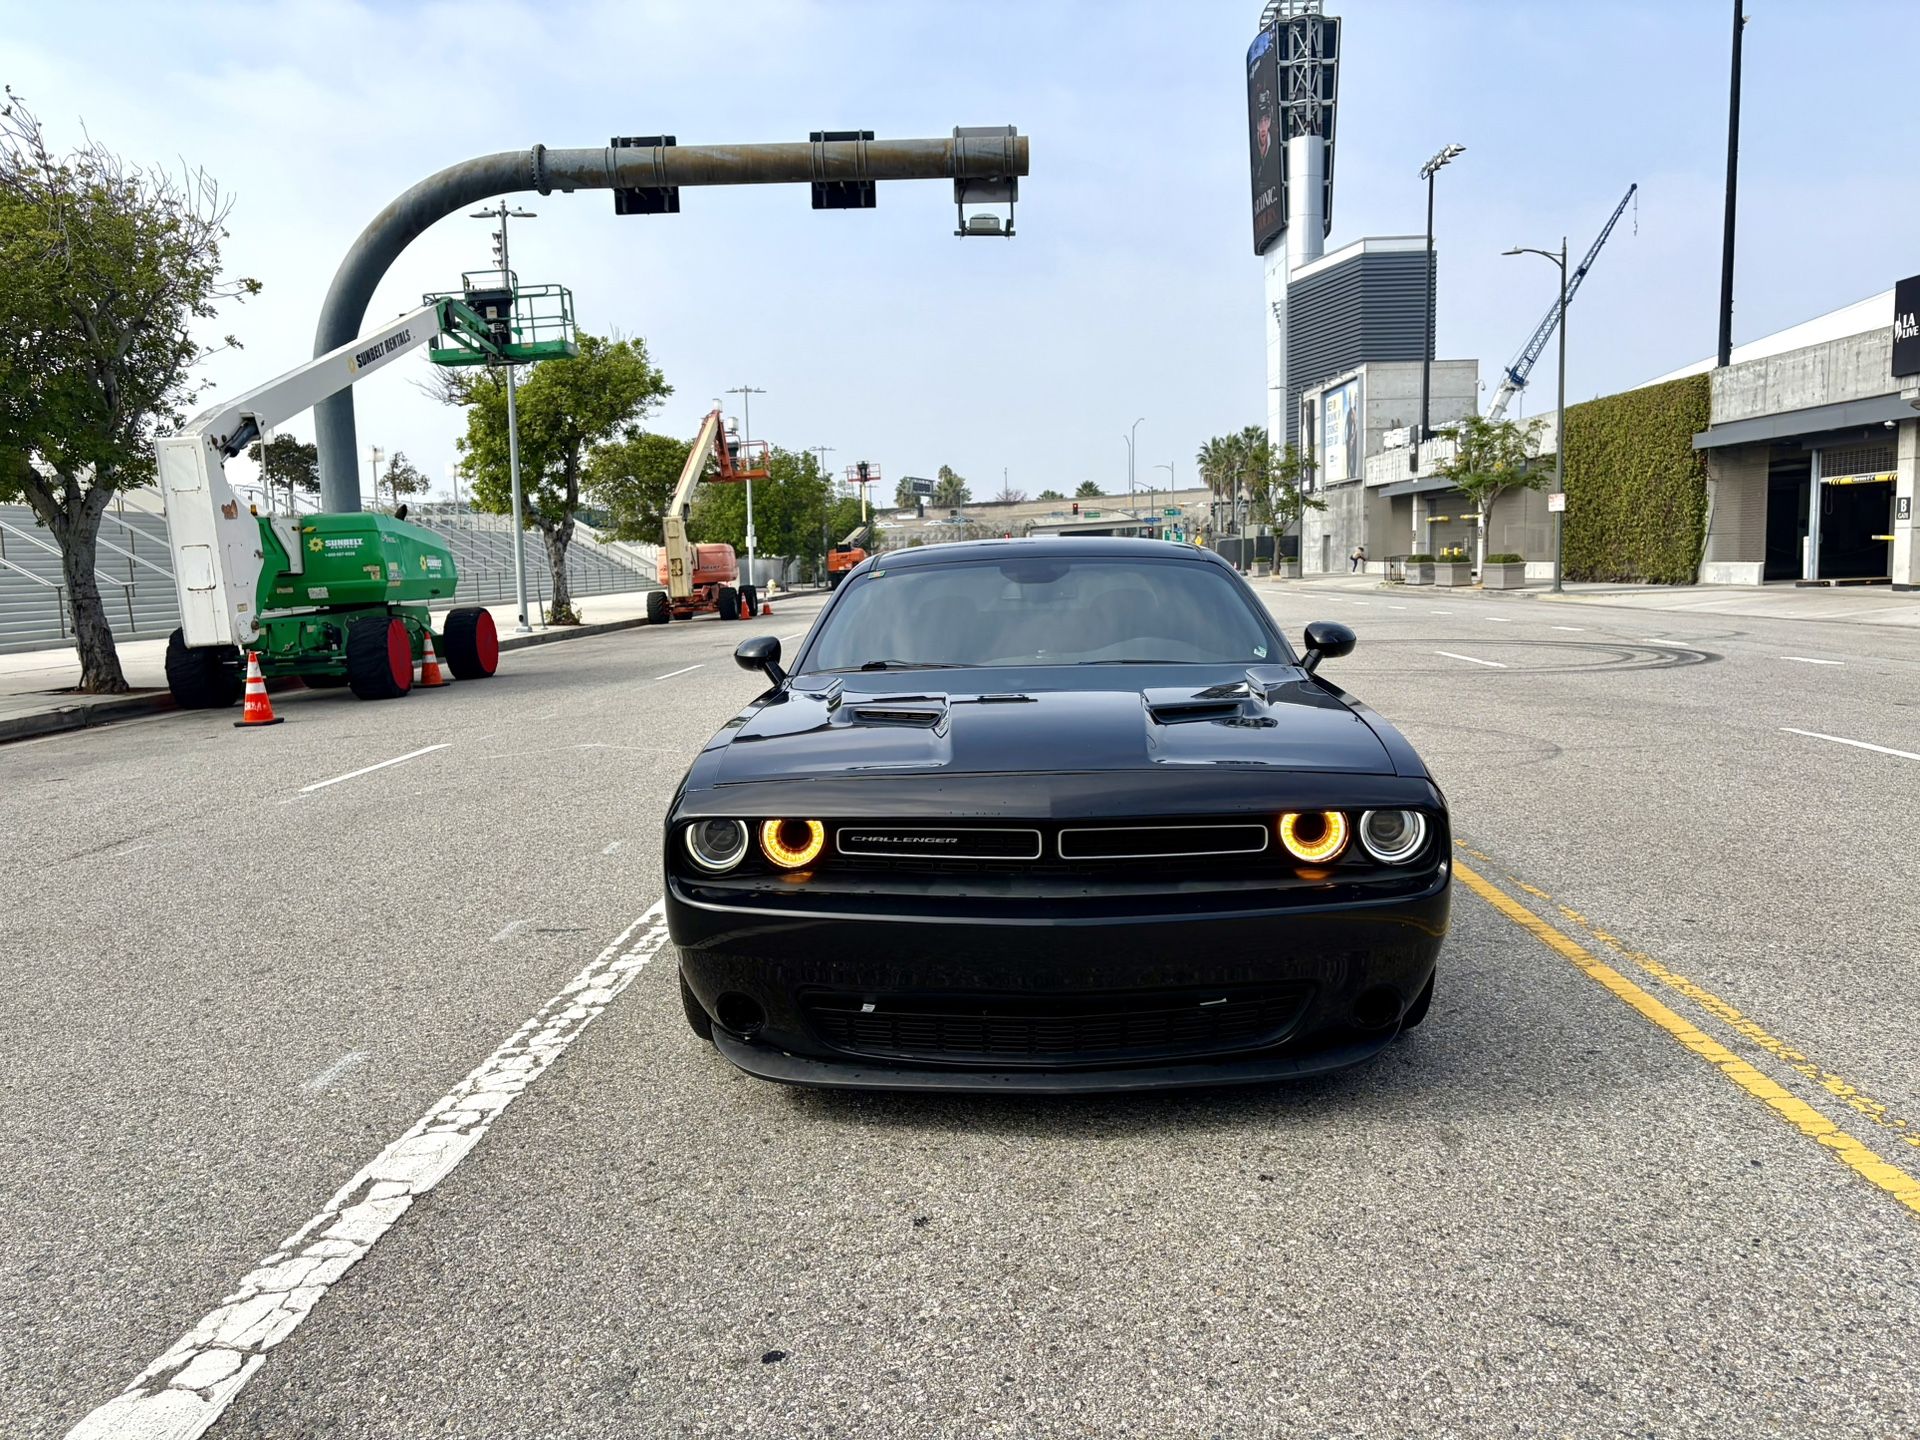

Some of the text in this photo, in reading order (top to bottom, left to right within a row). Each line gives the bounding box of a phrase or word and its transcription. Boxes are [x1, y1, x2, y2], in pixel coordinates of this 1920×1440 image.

[1903, 312, 1915, 328] LA
[1902, 325, 1919, 339] LIVE
[356, 328, 411, 369] SUNBELT RENTALS
[1901, 499, 1907, 512] B
[325, 538, 363, 548] SUNBELT
